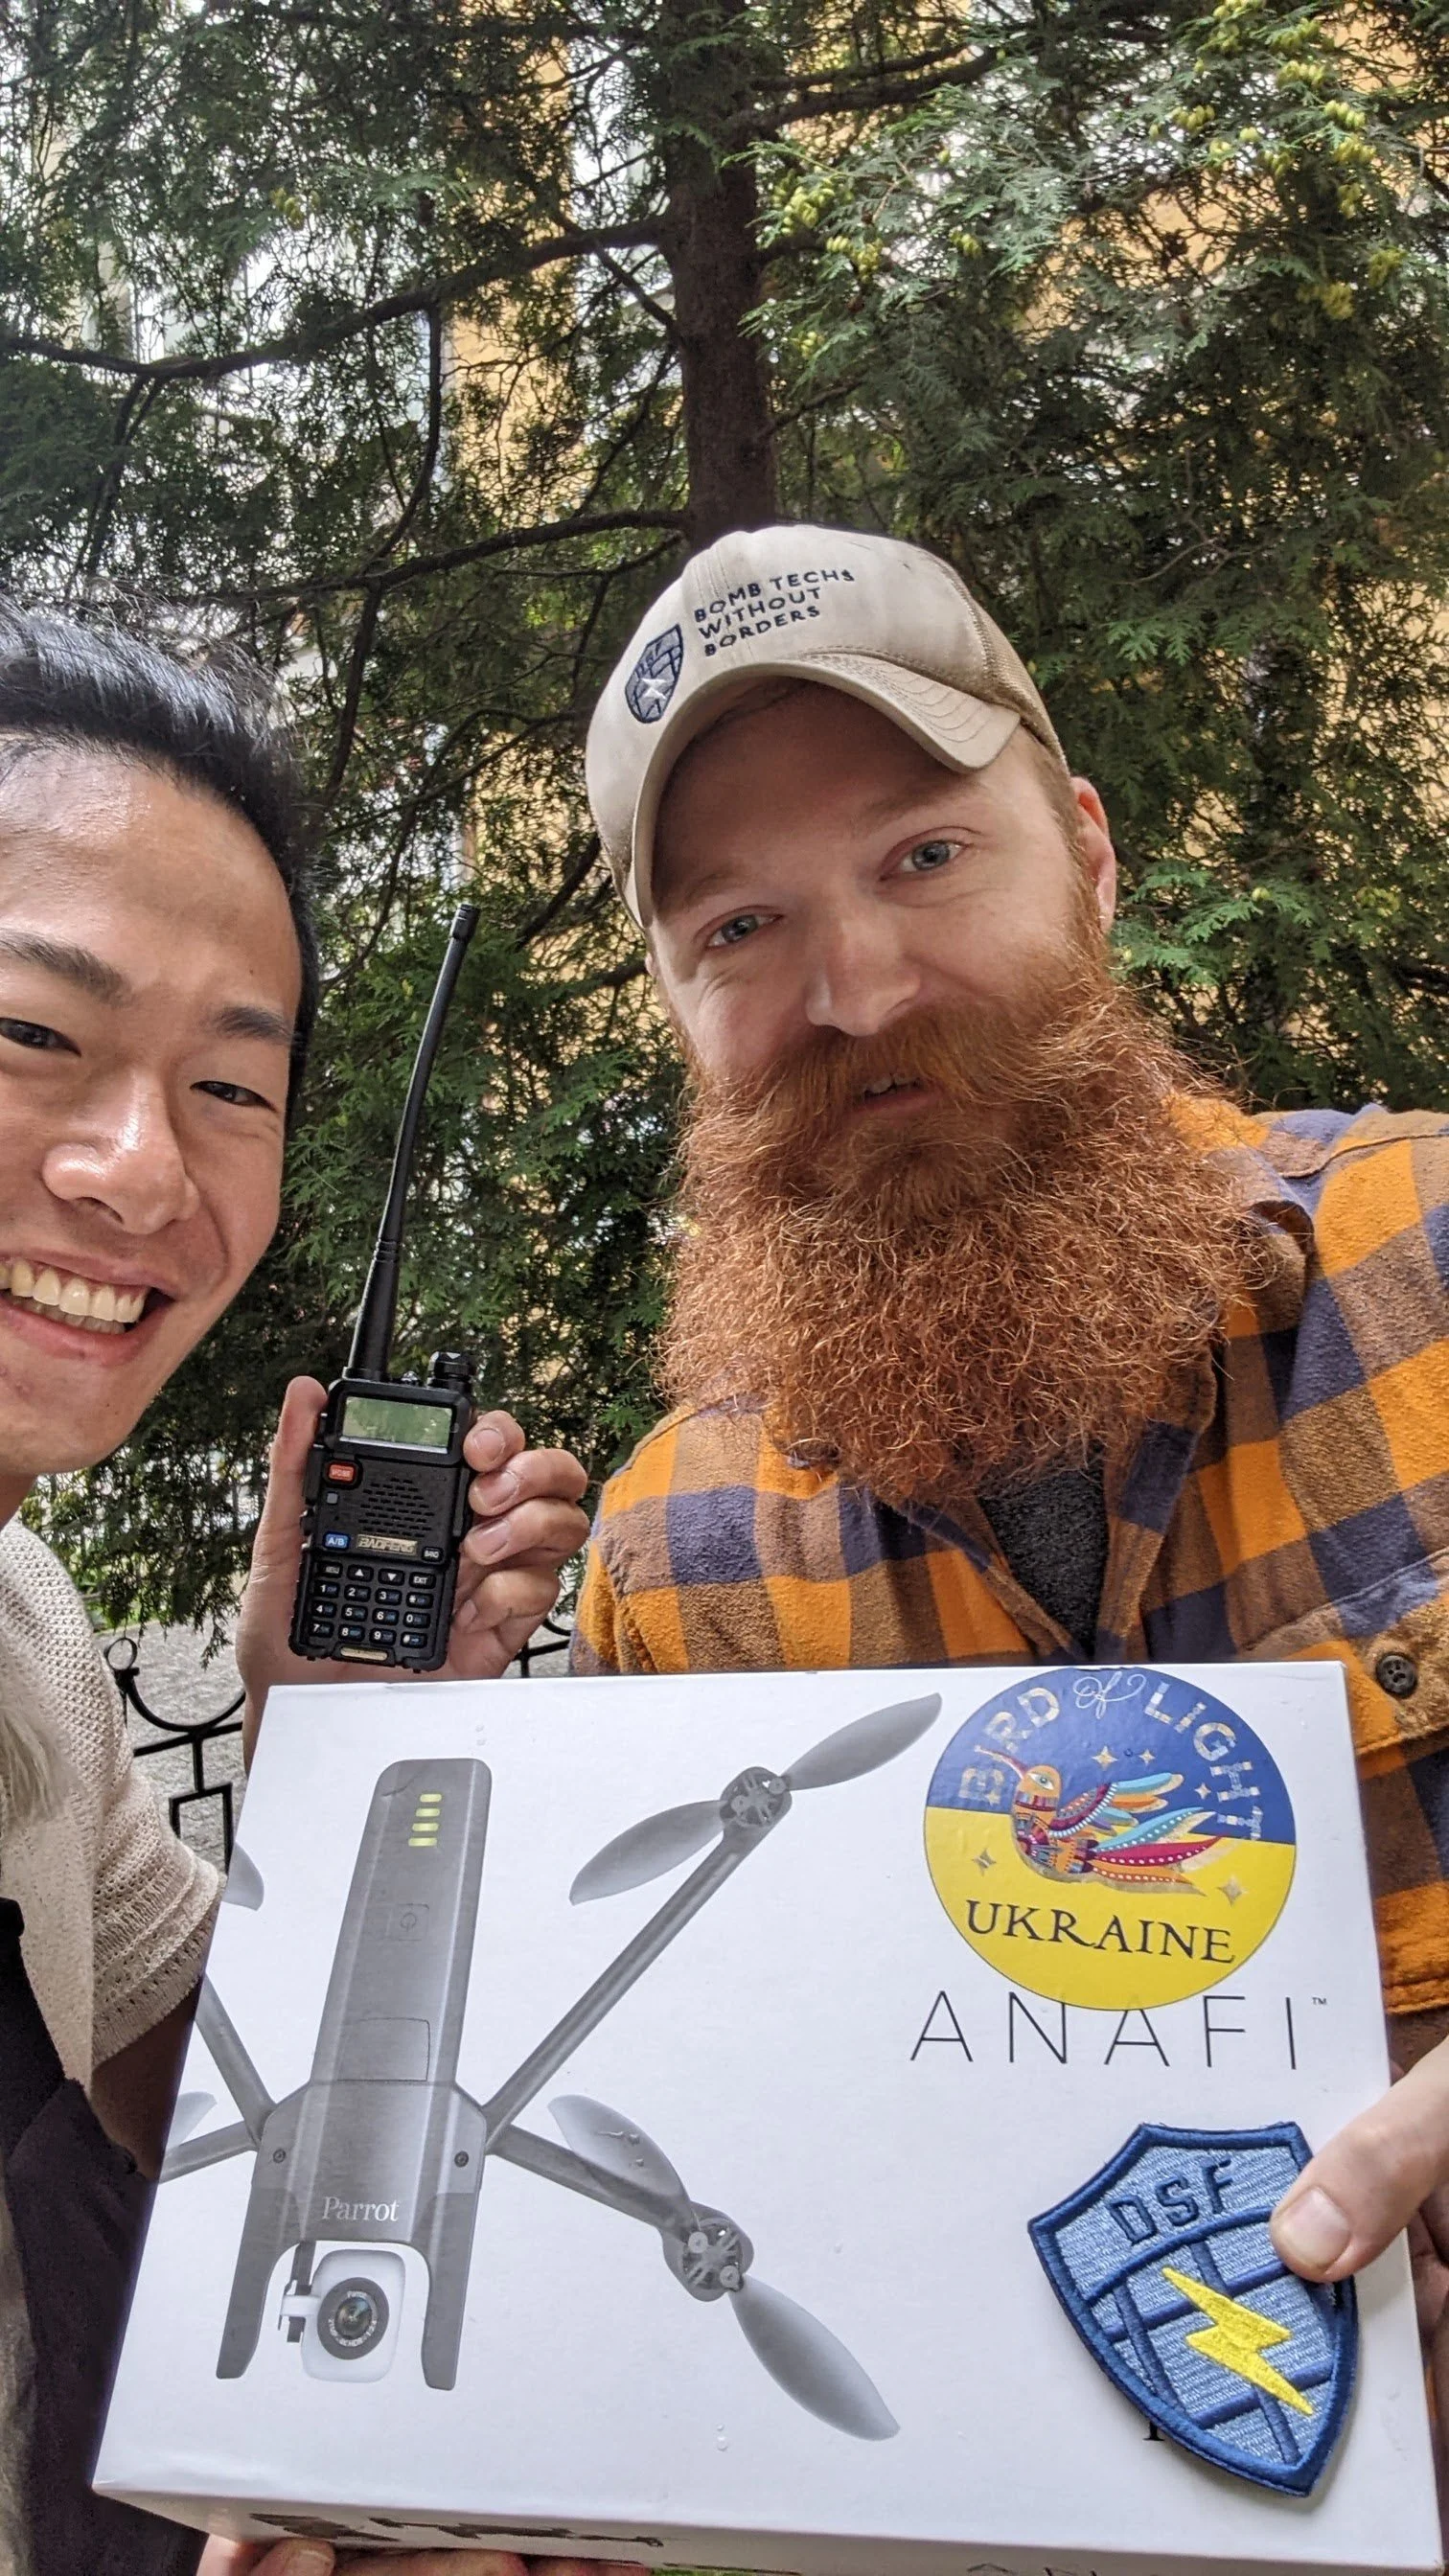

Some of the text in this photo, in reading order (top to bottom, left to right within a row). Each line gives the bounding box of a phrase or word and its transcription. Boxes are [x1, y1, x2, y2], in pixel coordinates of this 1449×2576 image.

[694, 568, 856, 623] BOMB TECHS
[699, 586, 822, 639] WITHOUT
[703, 607, 821, 657] BORDERS
[328, 1536, 346, 1546] A/B
[960, 1670, 1264, 1841] BIRD of LIGHT
[966, 1899, 1236, 1965] UKRAINE
[910, 1990, 1298, 2070] ANAFI
[321, 2196, 400, 2222] Parrot
[1109, 2157, 1234, 2245] DSF
